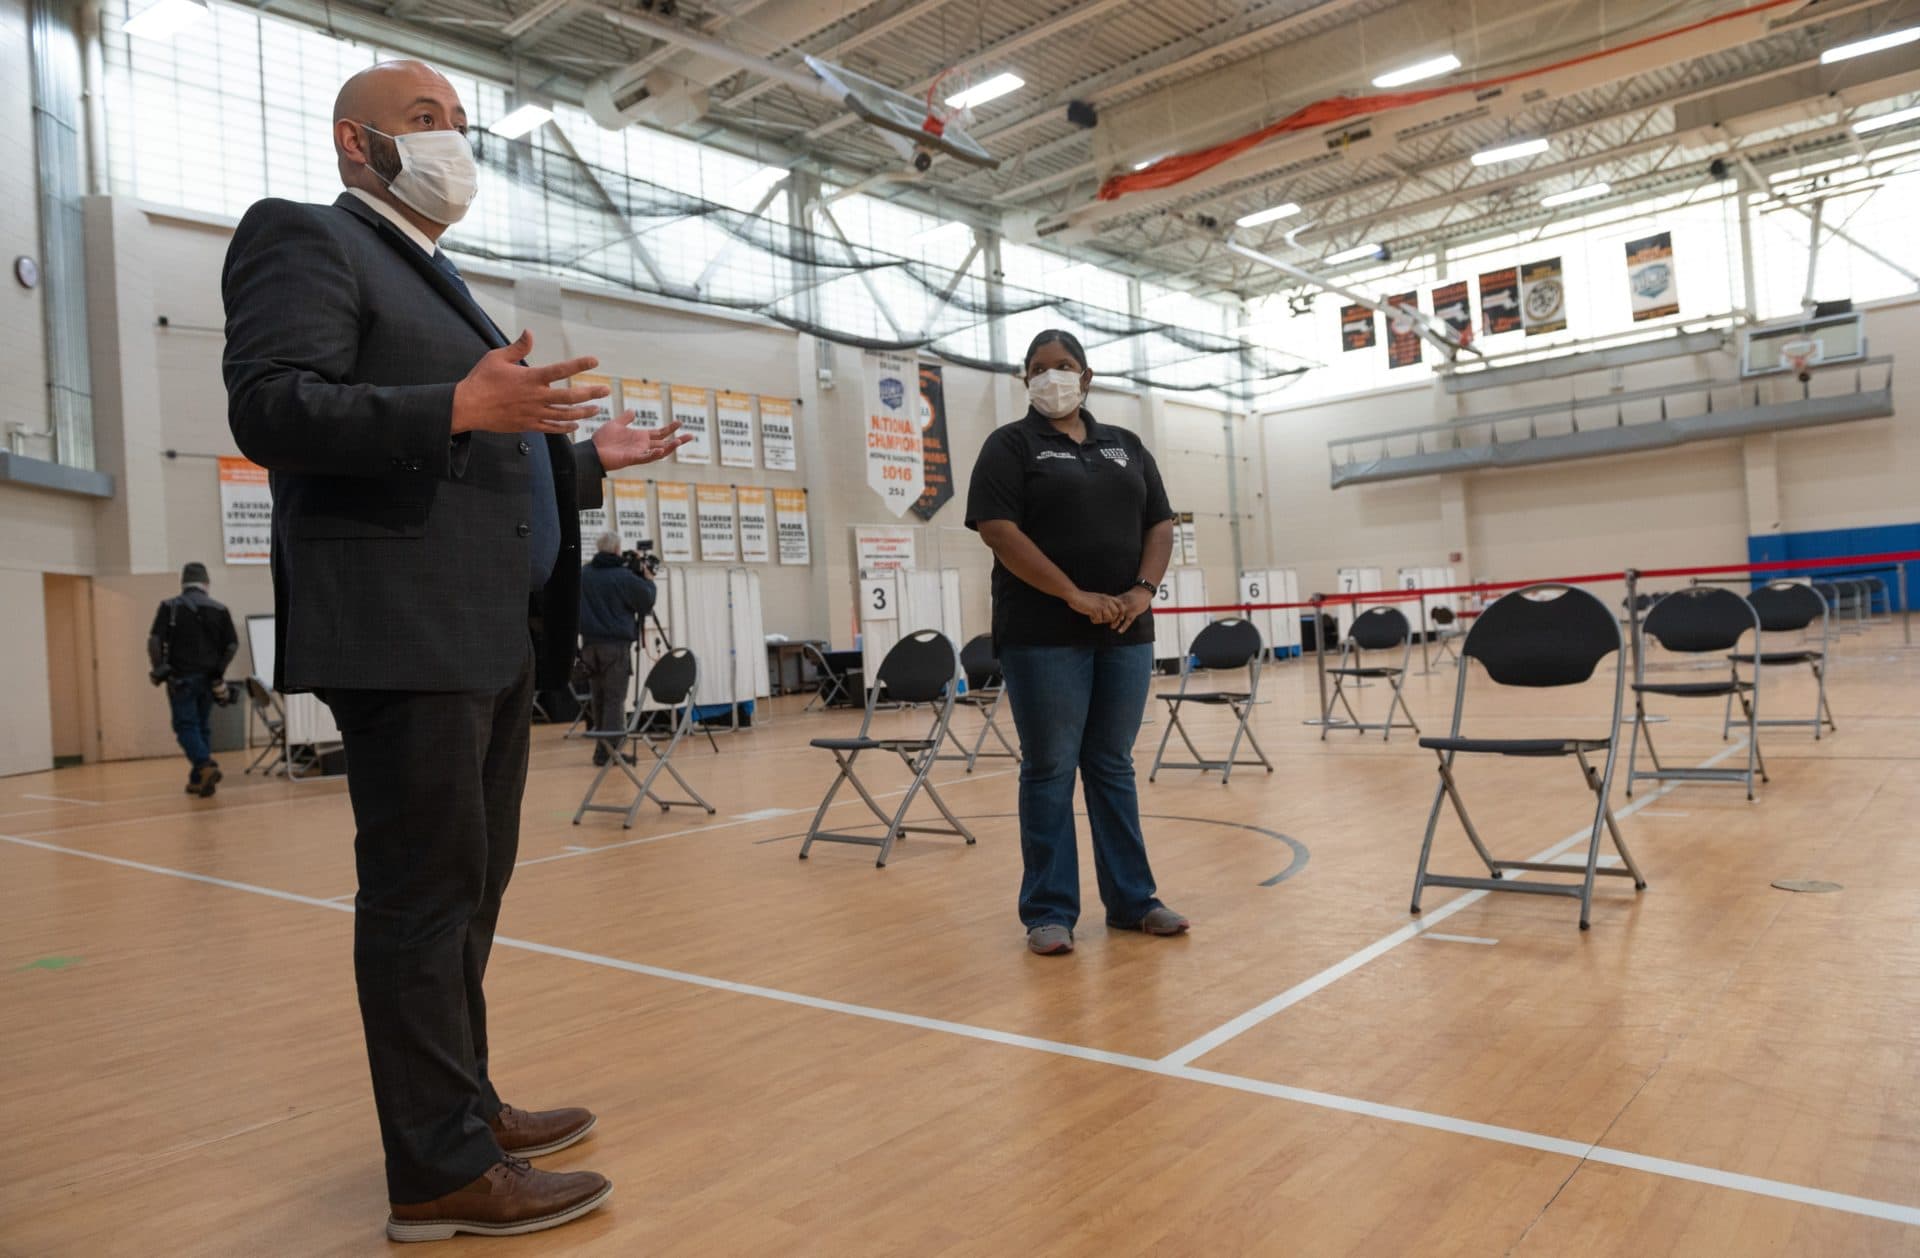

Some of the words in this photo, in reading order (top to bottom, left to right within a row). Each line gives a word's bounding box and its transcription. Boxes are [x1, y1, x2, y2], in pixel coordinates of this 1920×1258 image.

[1249, 583, 1260, 598] 6
[1344, 578, 1353, 592] 7
[1406, 577, 1415, 590] 8
[872, 587, 887, 610] 3
[1159, 583, 1169, 601] 5
